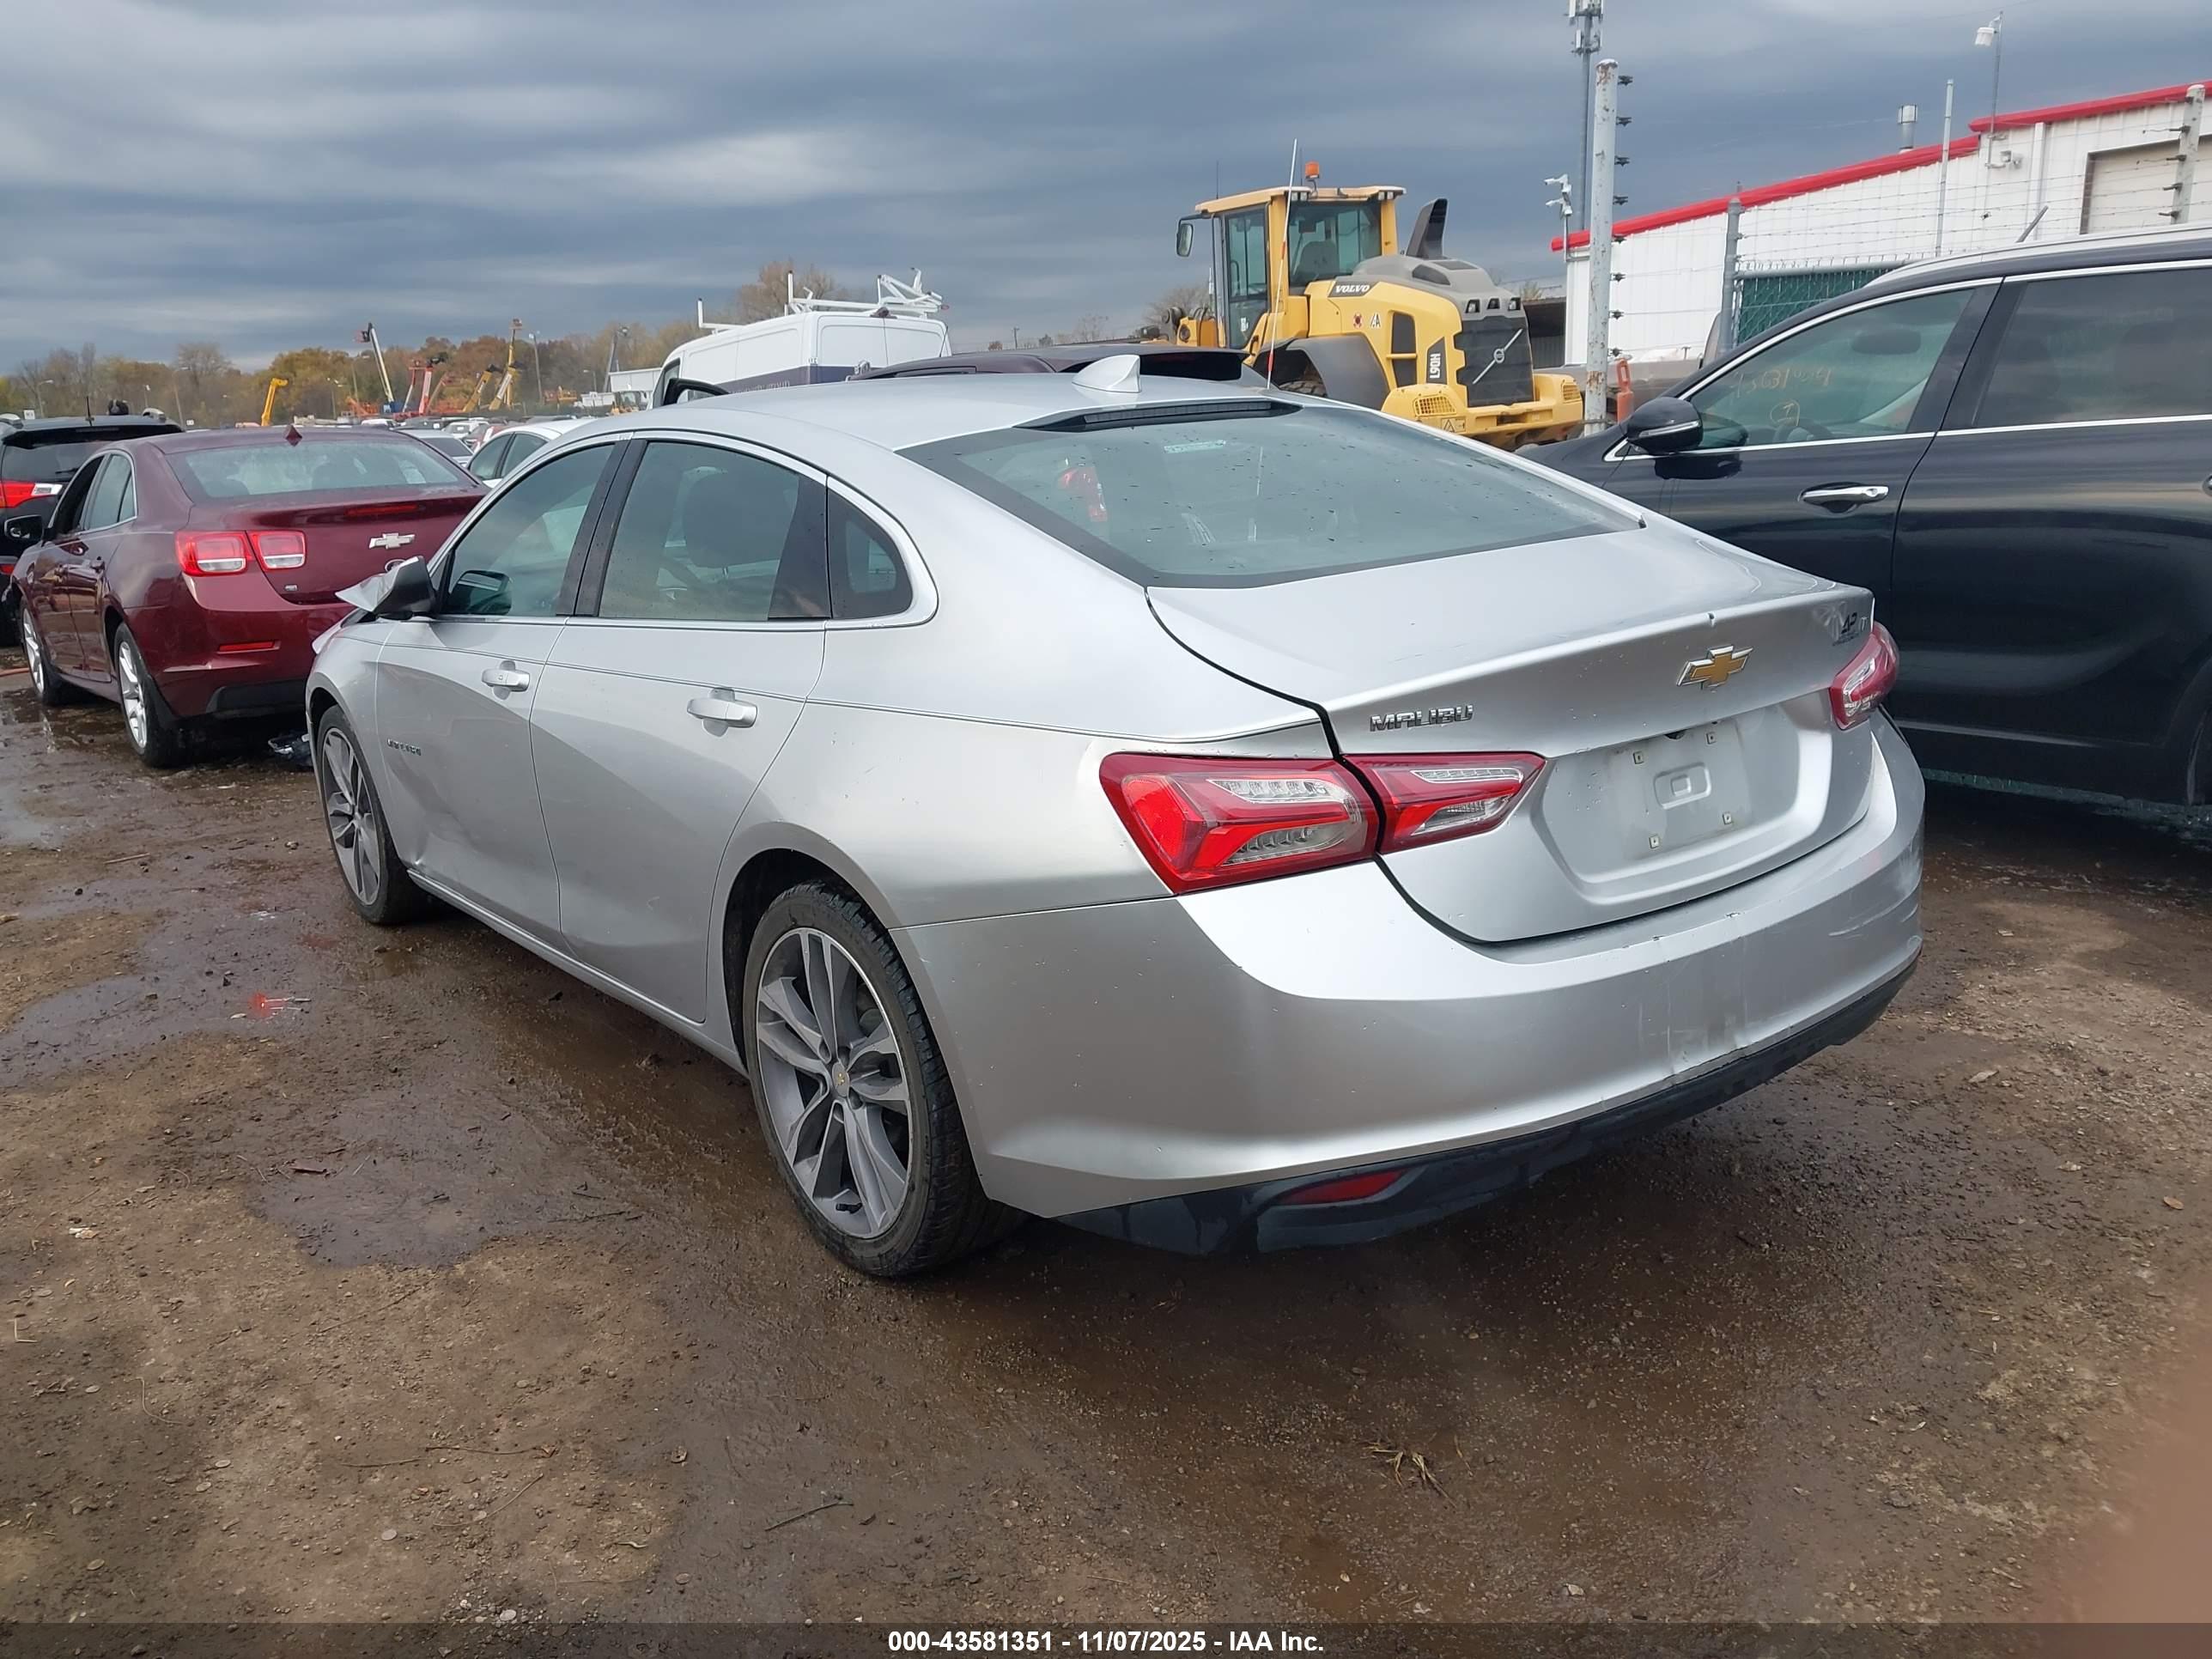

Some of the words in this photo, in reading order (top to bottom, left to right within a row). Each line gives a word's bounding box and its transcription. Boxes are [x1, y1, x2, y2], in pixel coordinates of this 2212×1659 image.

[1335, 284, 1370, 294] VOLVO
[1430, 353, 1441, 379] L90H
[1370, 705, 1474, 732] MALIBU
